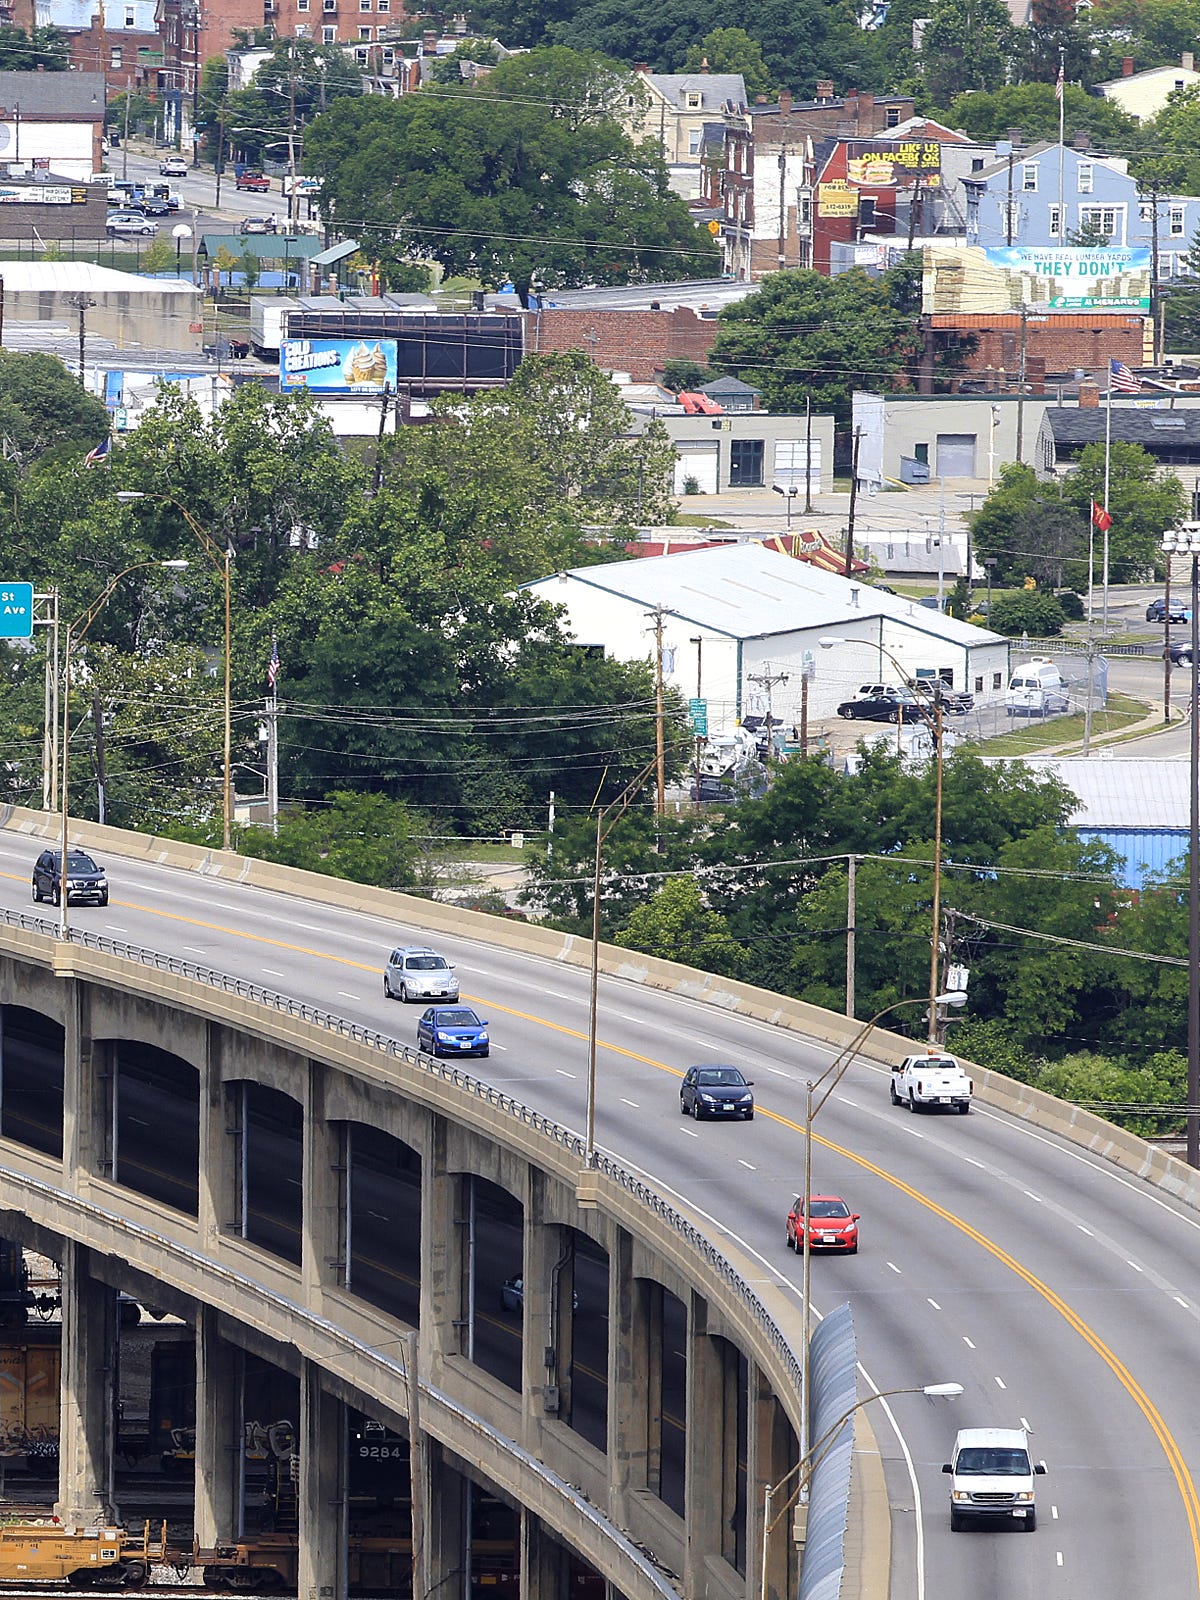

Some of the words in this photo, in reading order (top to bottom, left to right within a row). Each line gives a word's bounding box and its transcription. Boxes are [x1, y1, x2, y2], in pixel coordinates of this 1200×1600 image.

[924, 143, 940, 153] US
[862, 152, 881, 162] ON
[1033, 253, 1053, 261] HAVE
[1055, 253, 1073, 261] REAL
[1075, 253, 1105, 261] LUMBER
[1107, 253, 1132, 262] YARDS
[1033, 261, 1072, 276] THEY
[1078, 261, 1126, 276] DON'T
[285, 340, 311, 358] COLD
[284, 349, 338, 372] CREATIONS
[1, 591, 15, 602] St
[3, 605, 27, 615] Ave
[359, 1446, 400, 1458] 9284
